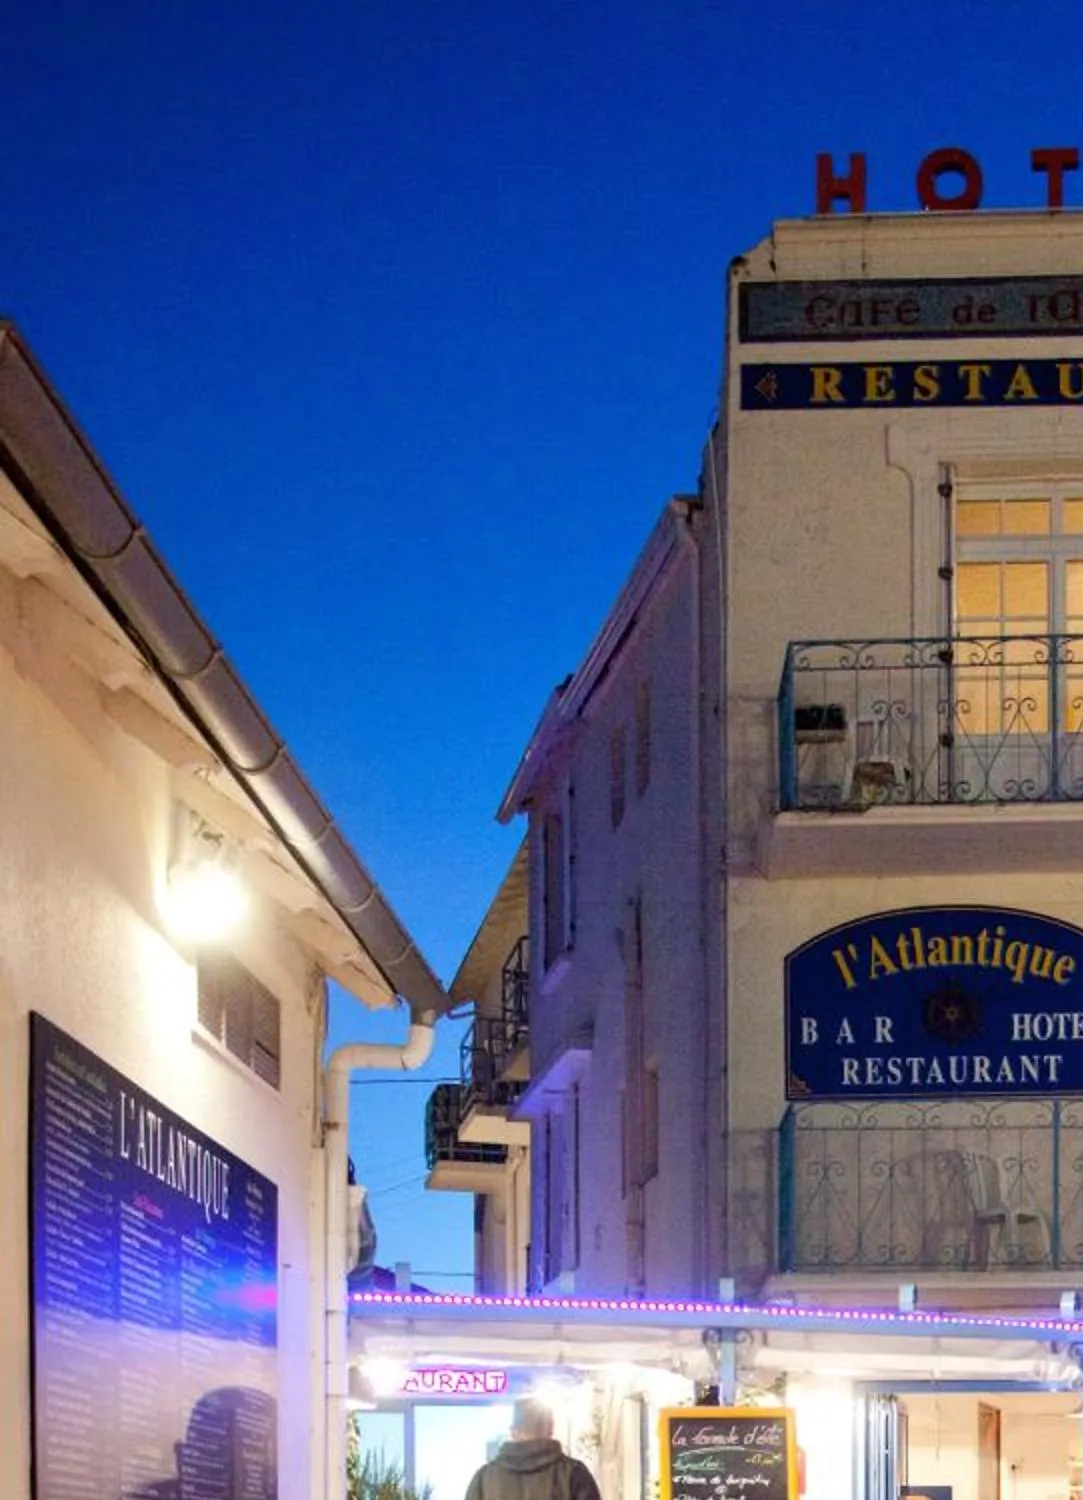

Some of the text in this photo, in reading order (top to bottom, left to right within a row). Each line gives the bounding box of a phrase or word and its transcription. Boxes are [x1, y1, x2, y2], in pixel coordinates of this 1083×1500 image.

[951, 295, 998, 325] de
[831, 925, 1077, 990] l'Atlantique
[800, 1015, 896, 1046] BAR
[841, 1053, 1064, 1087] RESTAURANT
[119, 1091, 231, 1224] L'ATLANTIQUE
[402, 1371, 505, 1392] AURANT
